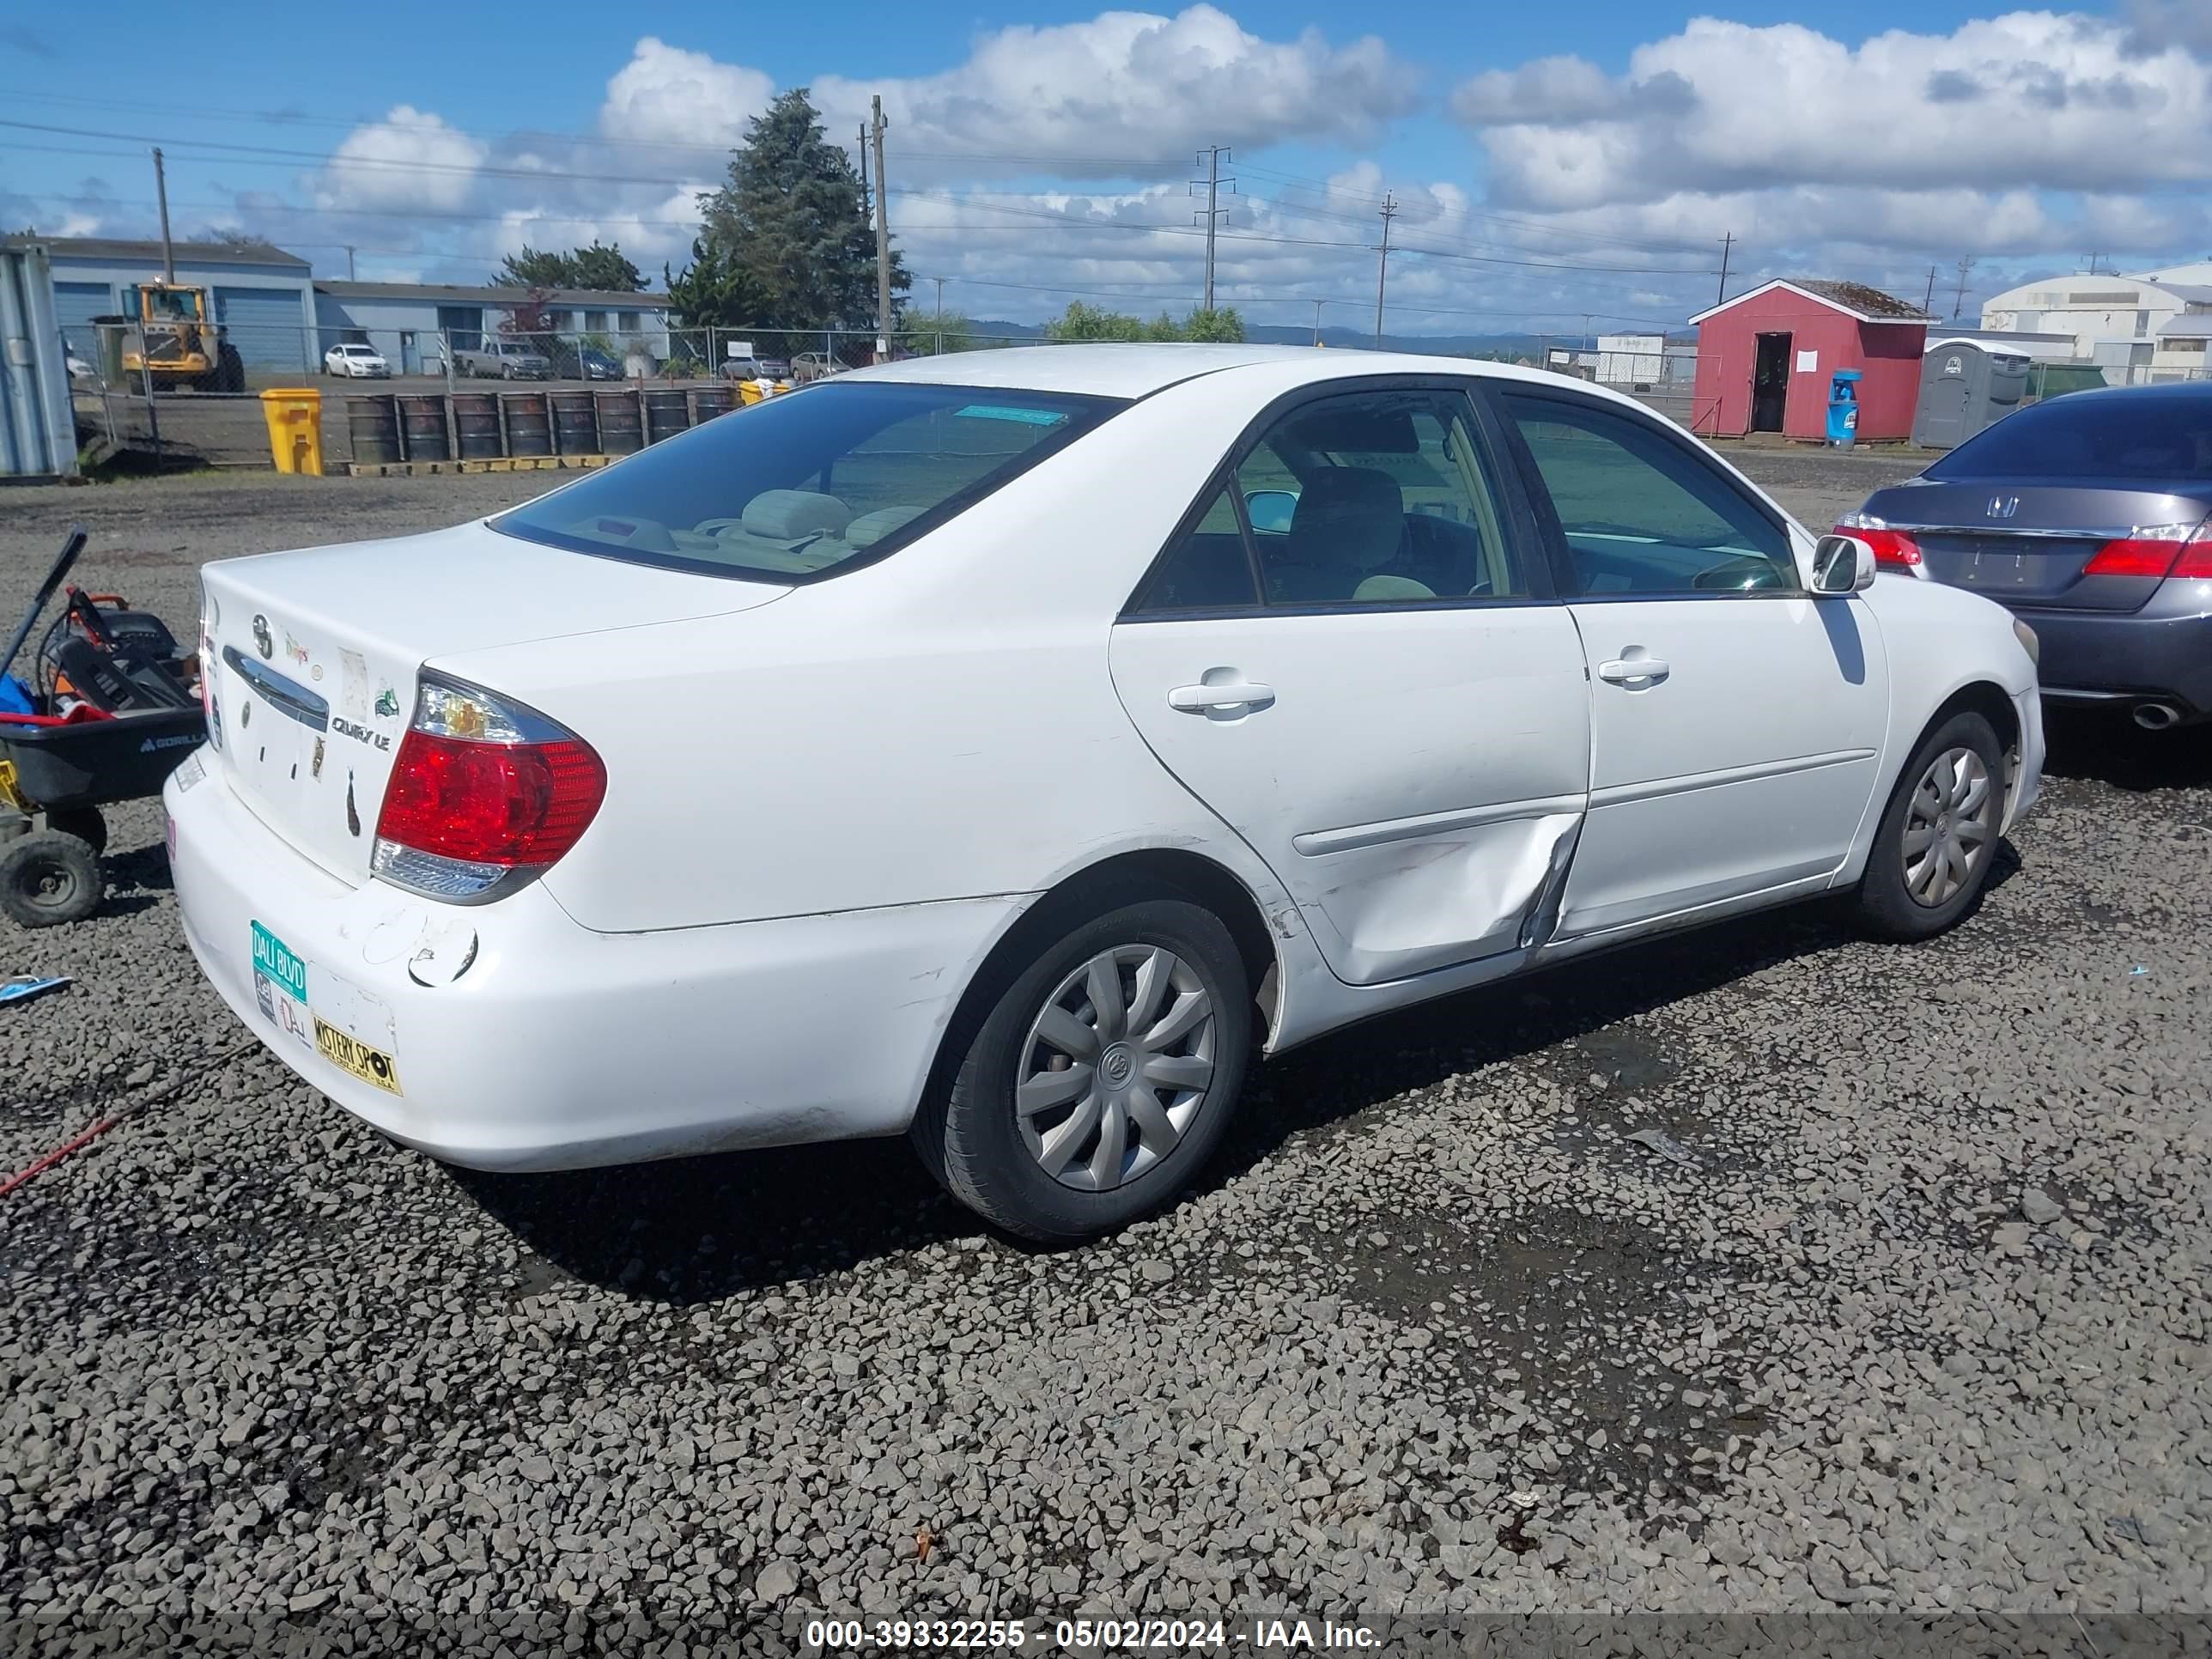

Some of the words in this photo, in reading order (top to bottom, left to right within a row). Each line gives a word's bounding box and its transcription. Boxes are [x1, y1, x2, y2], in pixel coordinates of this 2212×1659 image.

[374, 734, 391, 751] LE
[276, 948, 304, 990] BLVD
[313, 1016, 355, 1065] MYSTERY
[356, 1042, 395, 1083] SPOT
